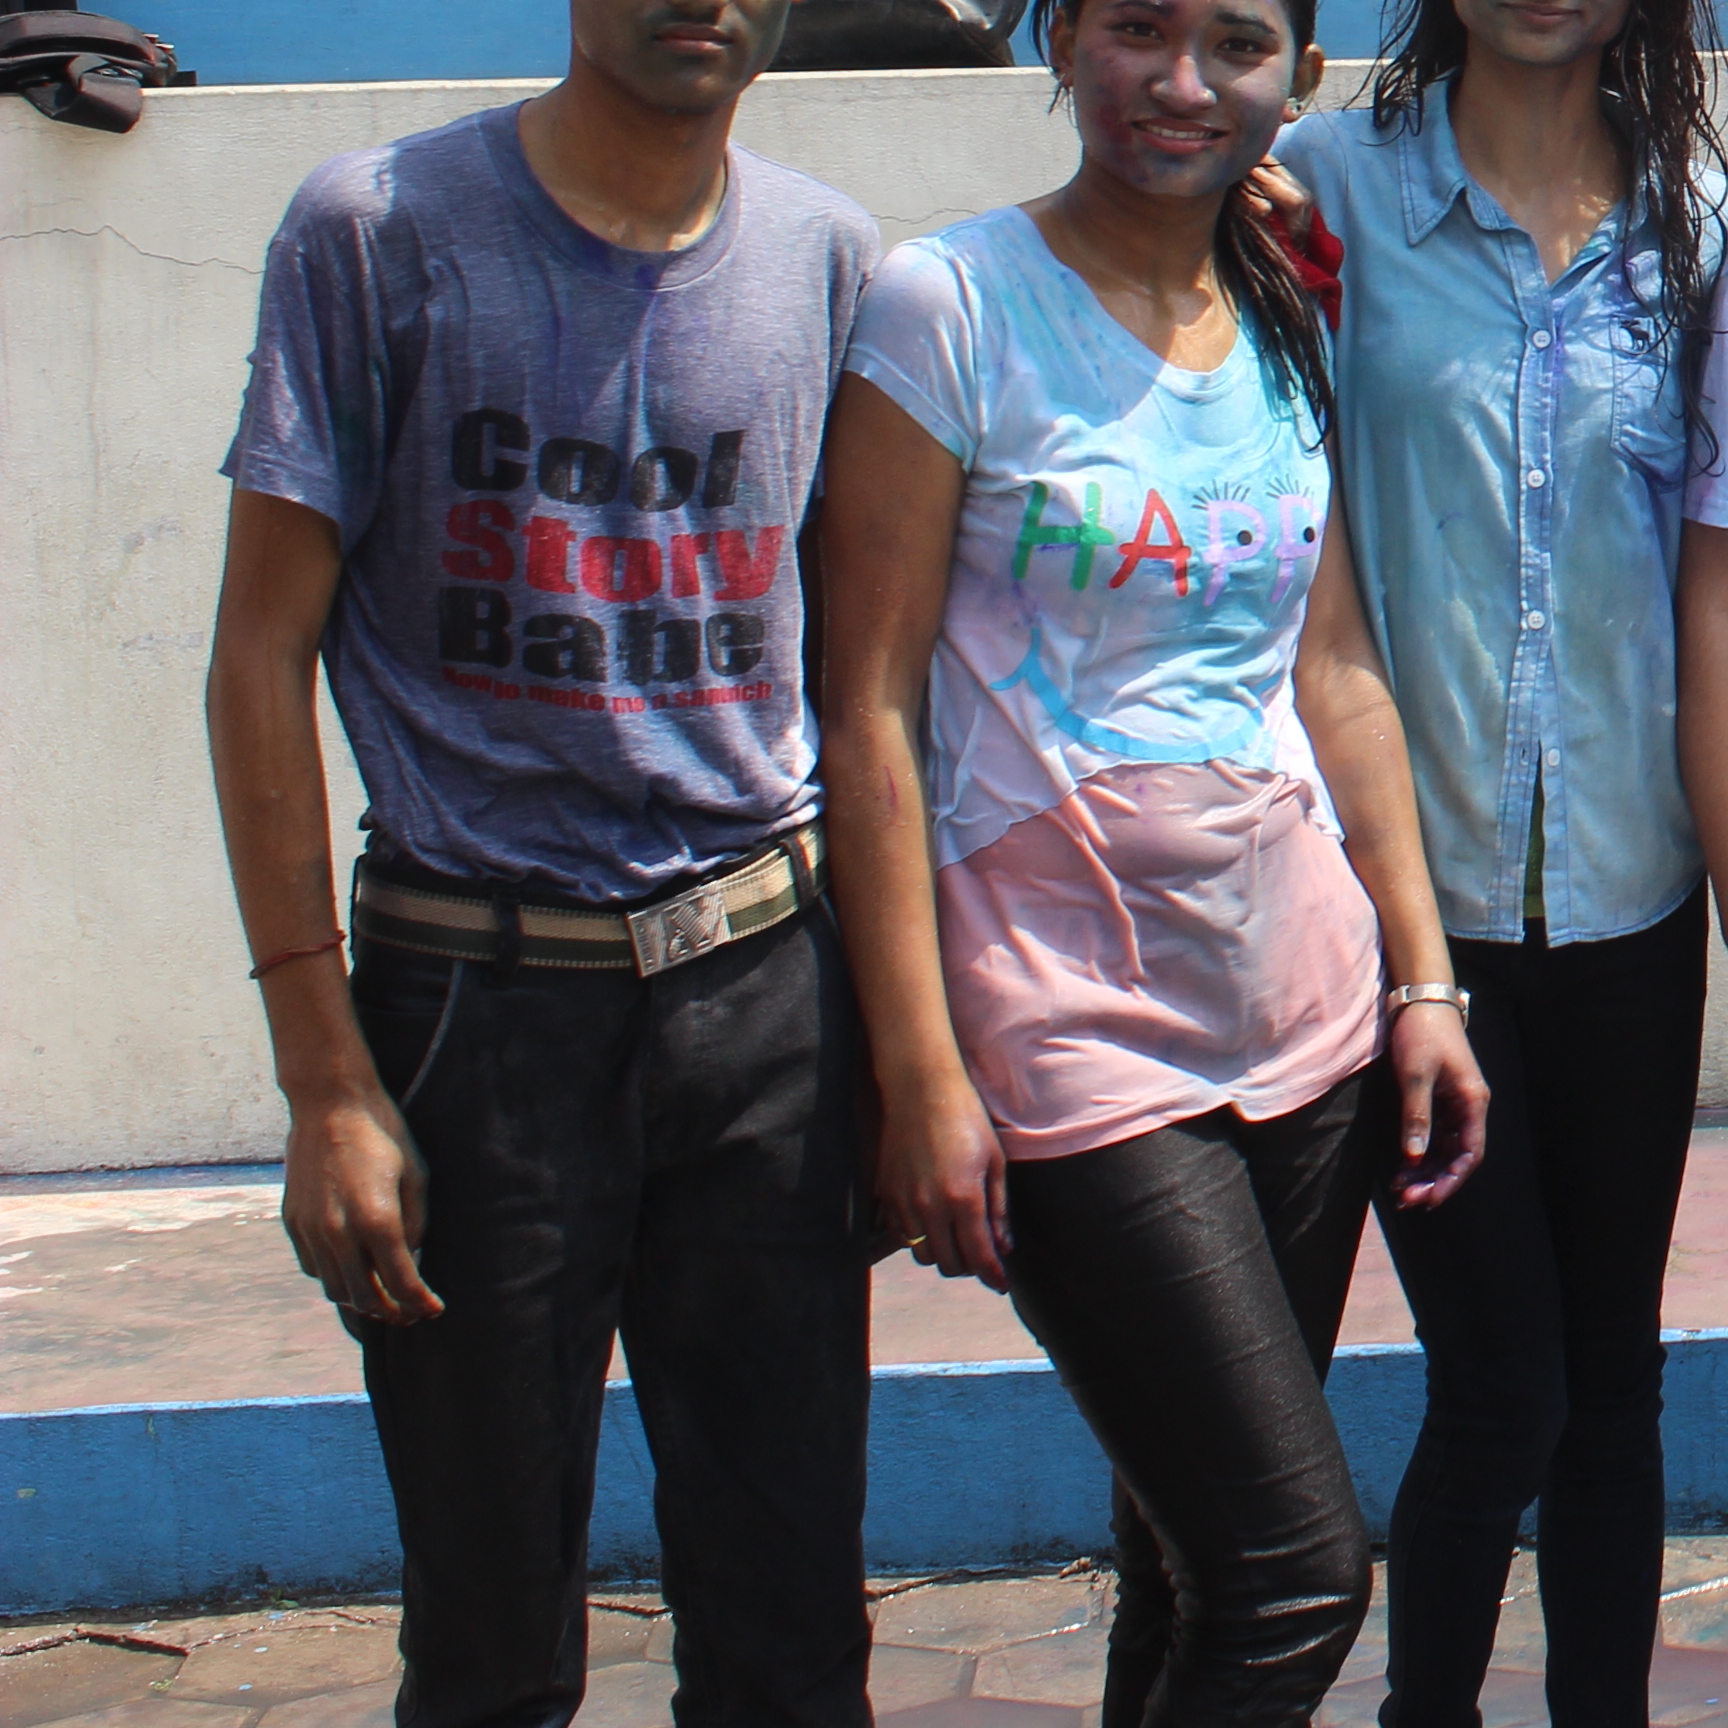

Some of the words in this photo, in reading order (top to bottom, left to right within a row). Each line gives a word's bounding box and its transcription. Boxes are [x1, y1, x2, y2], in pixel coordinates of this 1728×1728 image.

[452, 408, 747, 512] Cool
[442, 499, 785, 603] Story
[1011, 480, 1324, 607] HAPP
[438, 585, 766, 686] Babe
[527, 684, 605, 712] make
[611, 697, 646, 714] me
